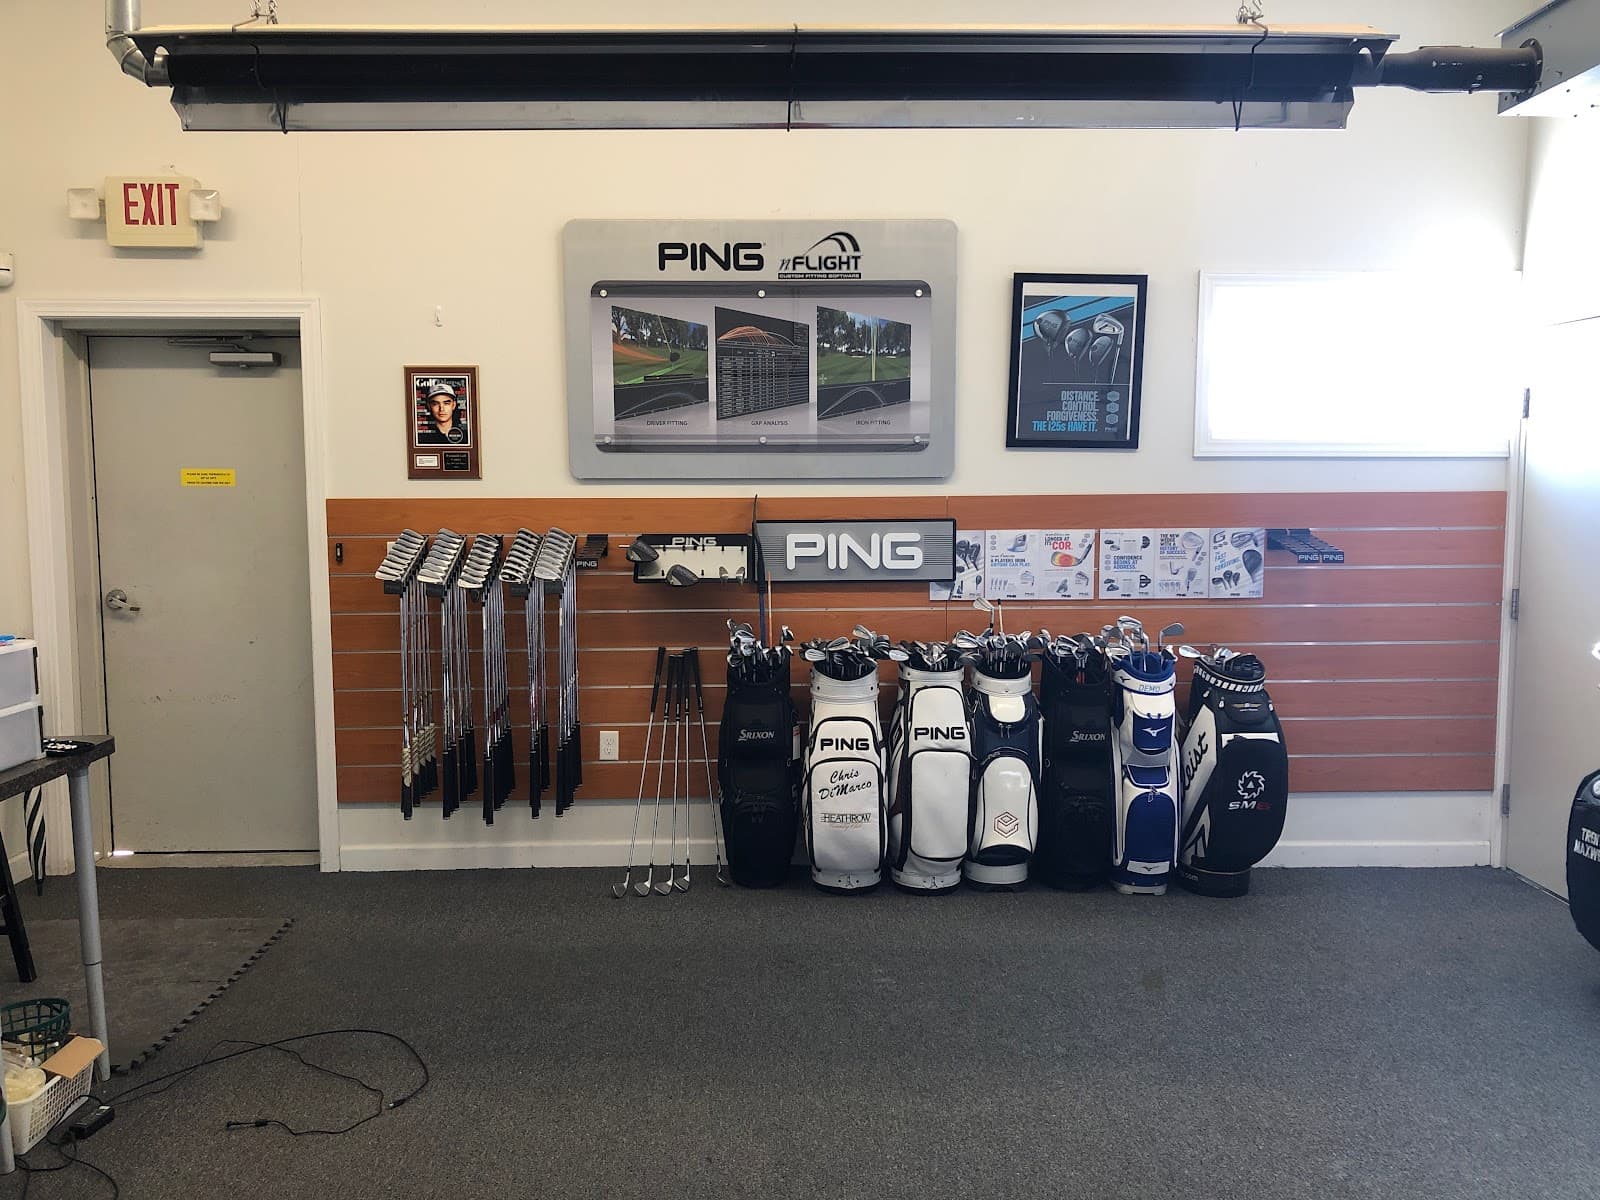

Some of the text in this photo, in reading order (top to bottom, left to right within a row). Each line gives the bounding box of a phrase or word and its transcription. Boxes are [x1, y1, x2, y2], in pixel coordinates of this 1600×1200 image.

[123, 183, 180, 226] EXIT
[658, 242, 764, 272] PING
[1046, 411, 1099, 422] FORGIVENESS.
[1032, 420, 1047, 432] THE
[1067, 421, 1087, 432] HAVE
[672, 536, 718, 546] PING
[786, 532, 923, 570] PING
[576, 560, 598, 568] PING
[738, 729, 775, 742] SRIXON
[914, 726, 966, 741] PING
[820, 738, 870, 751] PING
[830, 768, 860, 784] Chris
[818, 781, 872, 800] DiMarco
[820, 812, 872, 824] HEATHROW
